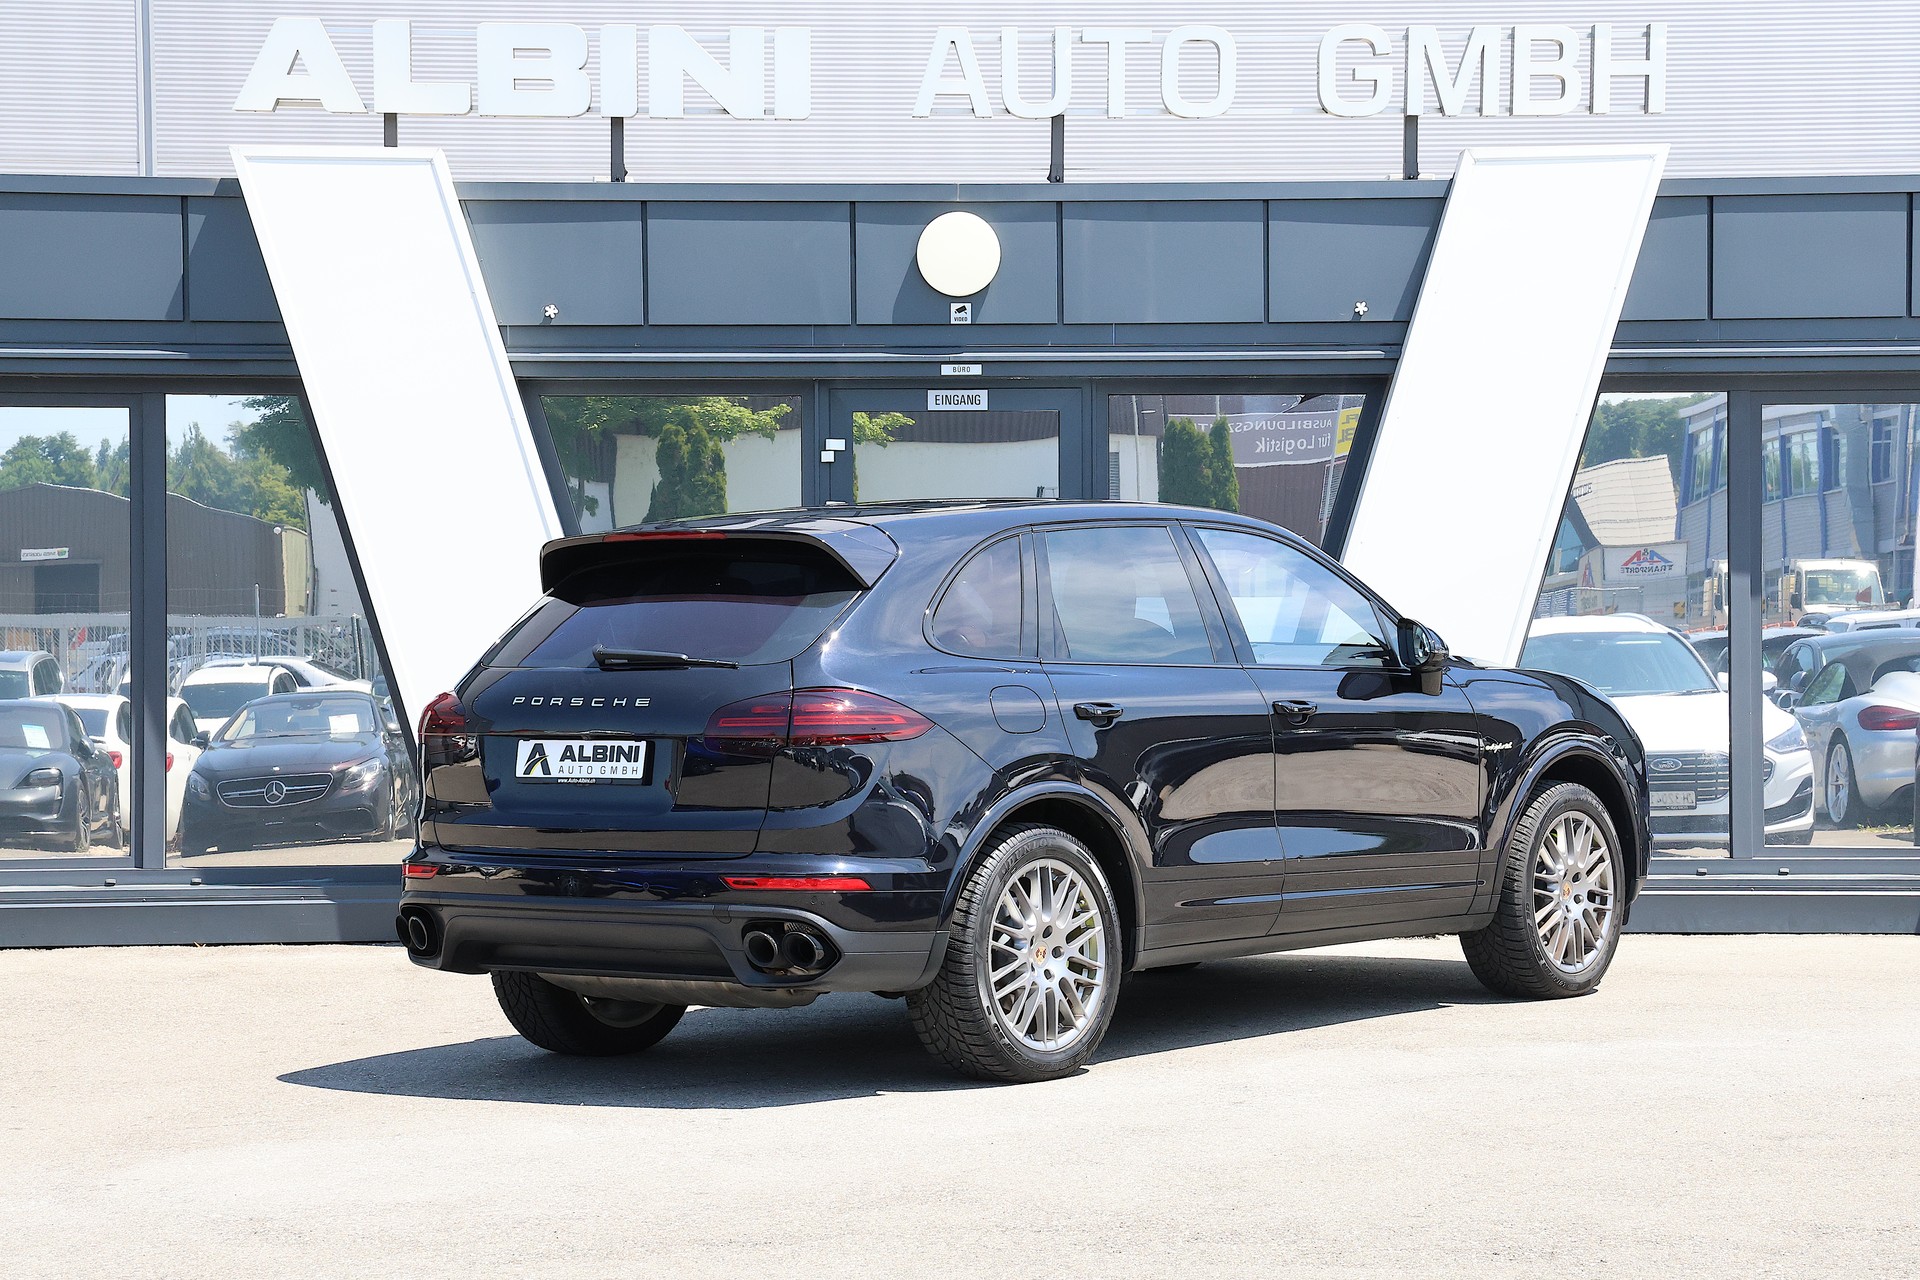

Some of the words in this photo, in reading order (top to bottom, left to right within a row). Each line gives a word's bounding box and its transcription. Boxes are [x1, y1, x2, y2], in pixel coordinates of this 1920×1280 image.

[232, 17, 812, 120] ALBINI
[912, 24, 1237, 119] AUTO
[1317, 23, 1668, 119] GMBH
[952, 365, 971, 373] BÜRO
[935, 394, 981, 406] EINGANG
[512, 696, 651, 707] PORSCHE
[559, 745, 641, 763] ALBINI
[558, 765, 593, 775] AUTO
[600, 765, 639, 775] GMBH
